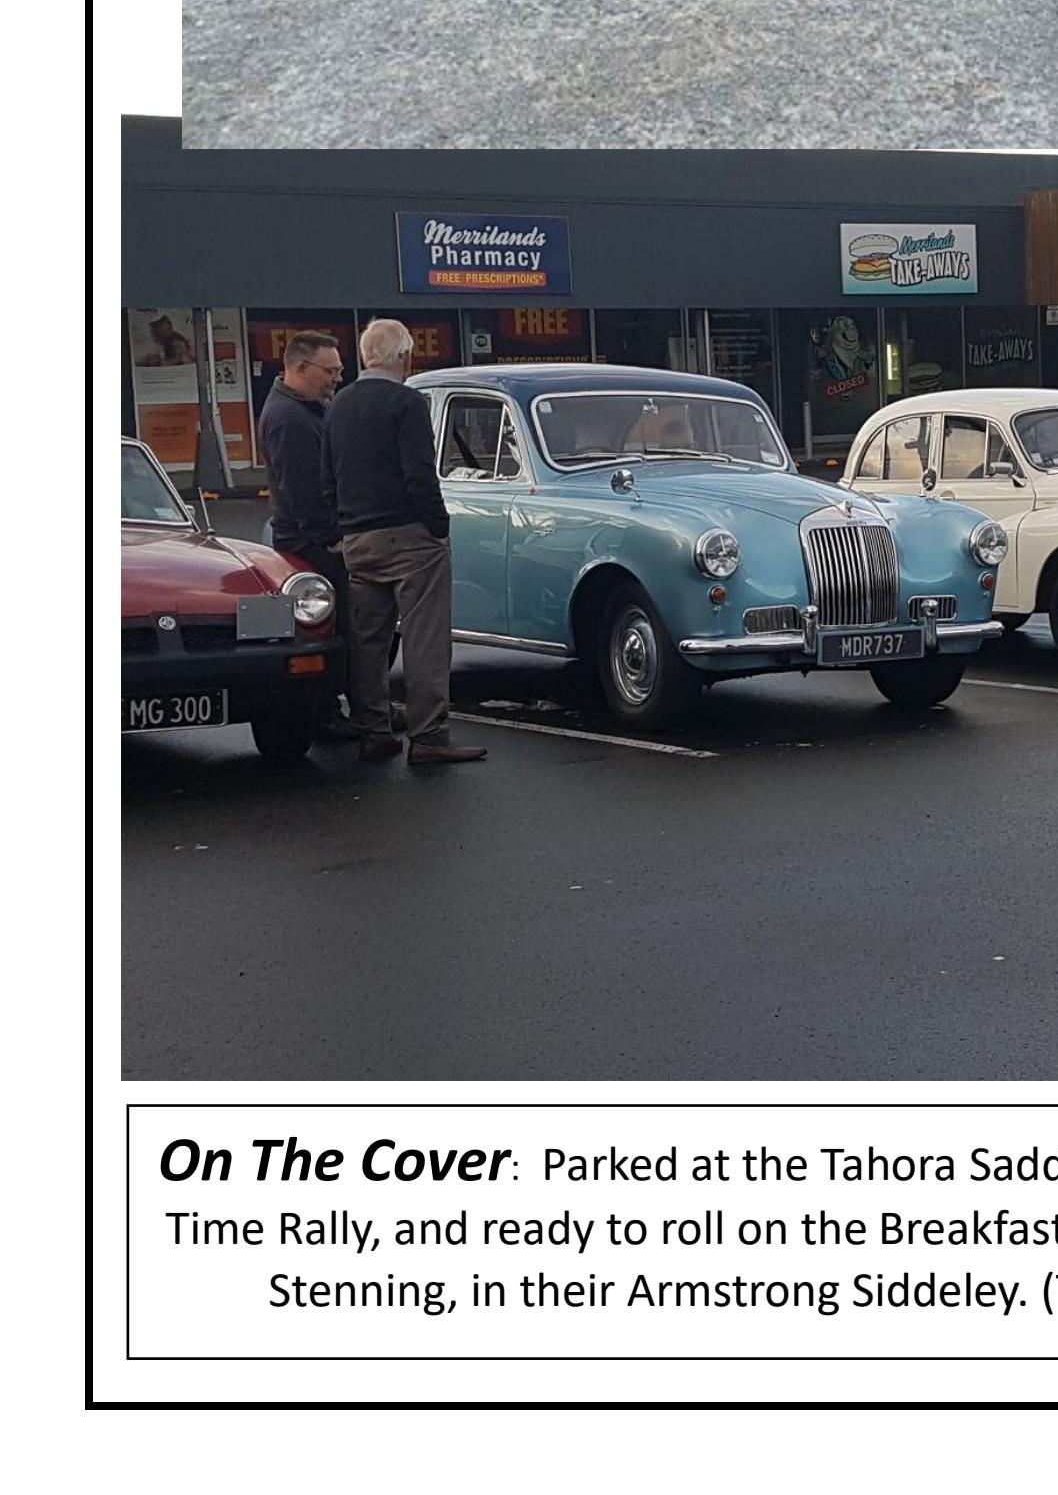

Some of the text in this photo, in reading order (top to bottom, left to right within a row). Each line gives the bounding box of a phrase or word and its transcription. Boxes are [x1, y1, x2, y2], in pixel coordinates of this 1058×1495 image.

[424, 220, 547, 247] Merrilands
[431, 245, 541, 270] Pharmacy
[889, 251, 970, 285] TAKE-AWAYS
[437, 274, 461, 283] FREE
[514, 308, 569, 335] FREE
[967, 338, 1034, 366] TAKE-AWAYS
[826, 375, 866, 396] CLOSED
[841, 634, 903, 658] MDR737
[130, 695, 212, 727] MG 300
[161, 1139, 232, 1181] On
[253, 1137, 344, 1181] The
[362, 1139, 518, 1181] Cover:
[545, 1147, 676, 1181] Parked
[692, 1150, 729, 1181] at
[742, 1147, 807, 1181] the
[821, 1147, 954, 1181] Tahora
[166, 1212, 263, 1245] Time
[281, 1211, 379, 1253] Rally,
[395, 1211, 466, 1245] and
[485, 1211, 594, 1253] ready
[607, 1214, 646, 1245] to
[664, 1211, 722, 1245] roll
[739, 1220, 786, 1245] on
[801, 1211, 866, 1245] the
[270, 1274, 456, 1315] Stenning,
[474, 1274, 504, 1306] in
[520, 1272, 615, 1307] their
[628, 1275, 839, 1315] Armstrong
[853, 1273, 1026, 1315] Siddeley.
